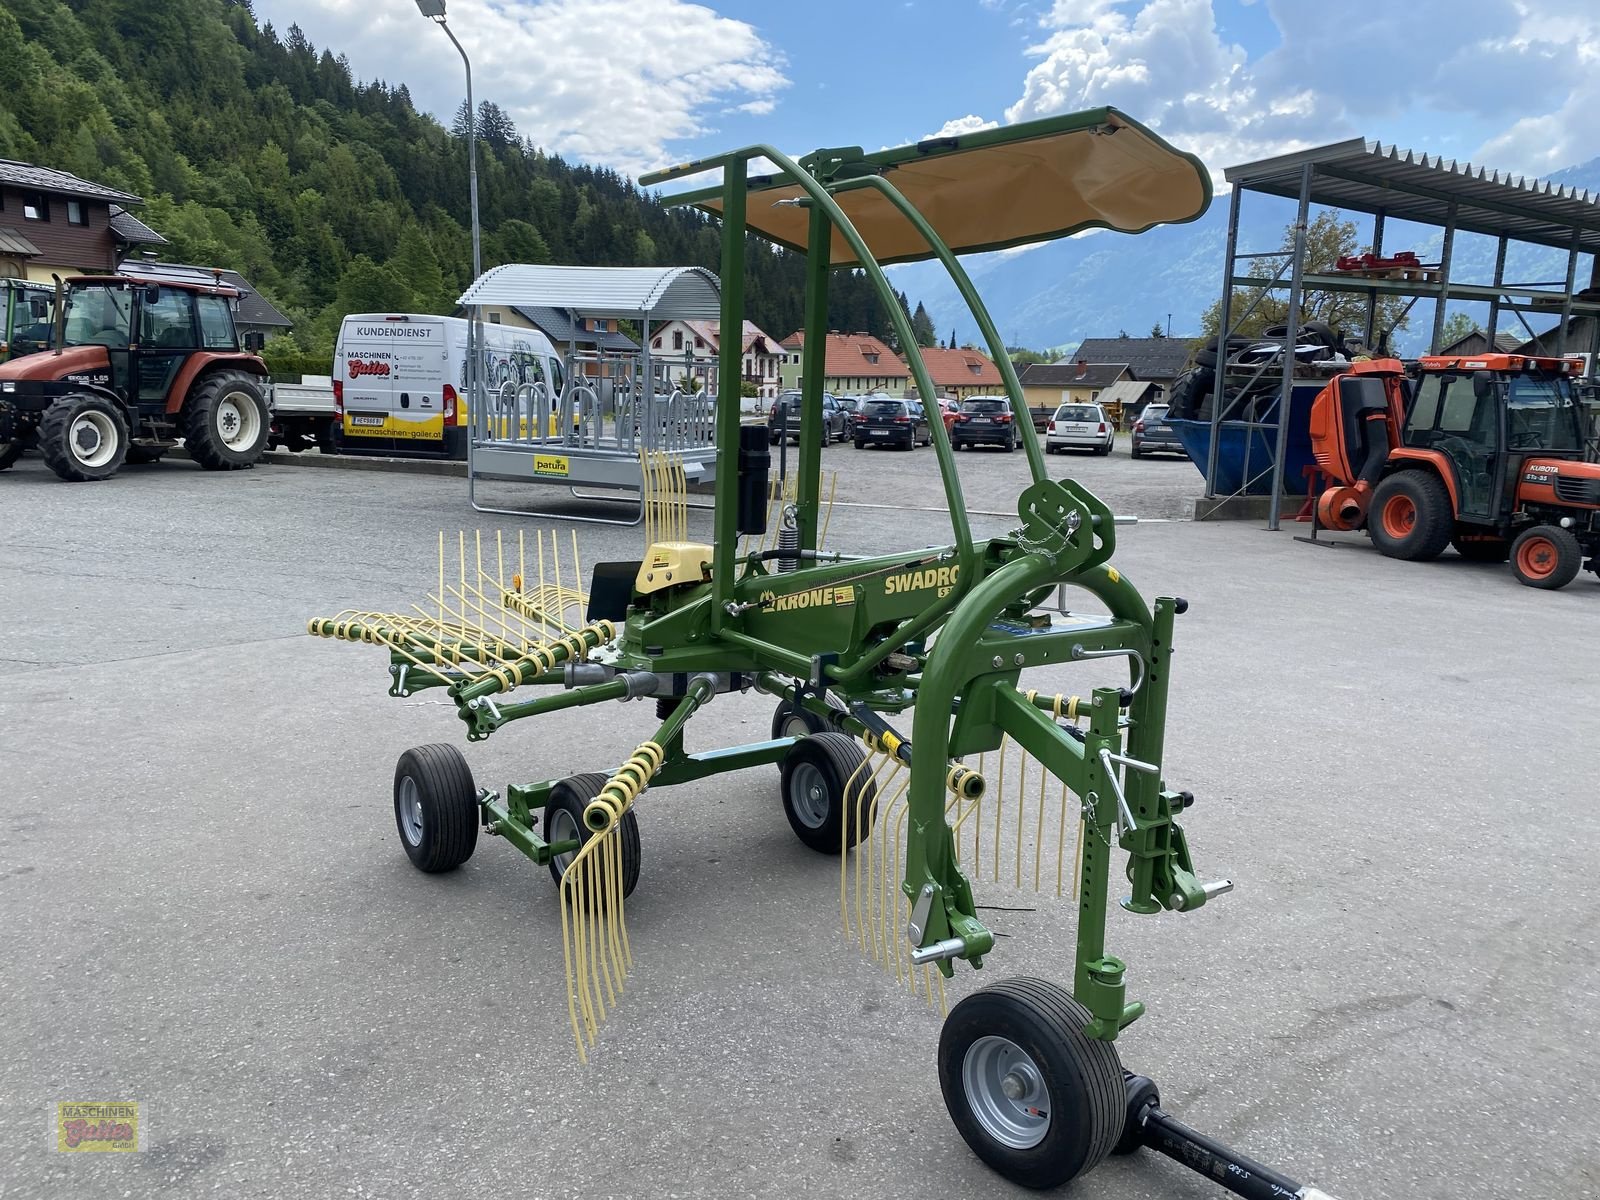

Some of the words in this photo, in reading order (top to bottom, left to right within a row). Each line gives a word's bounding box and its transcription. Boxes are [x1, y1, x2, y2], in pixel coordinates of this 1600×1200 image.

[357, 327, 432, 337] KUNDENDIENST
[347, 351, 391, 359] MASCHINEN
[348, 359, 390, 379] Gailer
[348, 428, 441, 438] www.maschinen-gailer.at
[537, 460, 566, 470] patura
[1530, 465, 1559, 473] KUBOTA
[776, 587, 834, 612] KRONE
